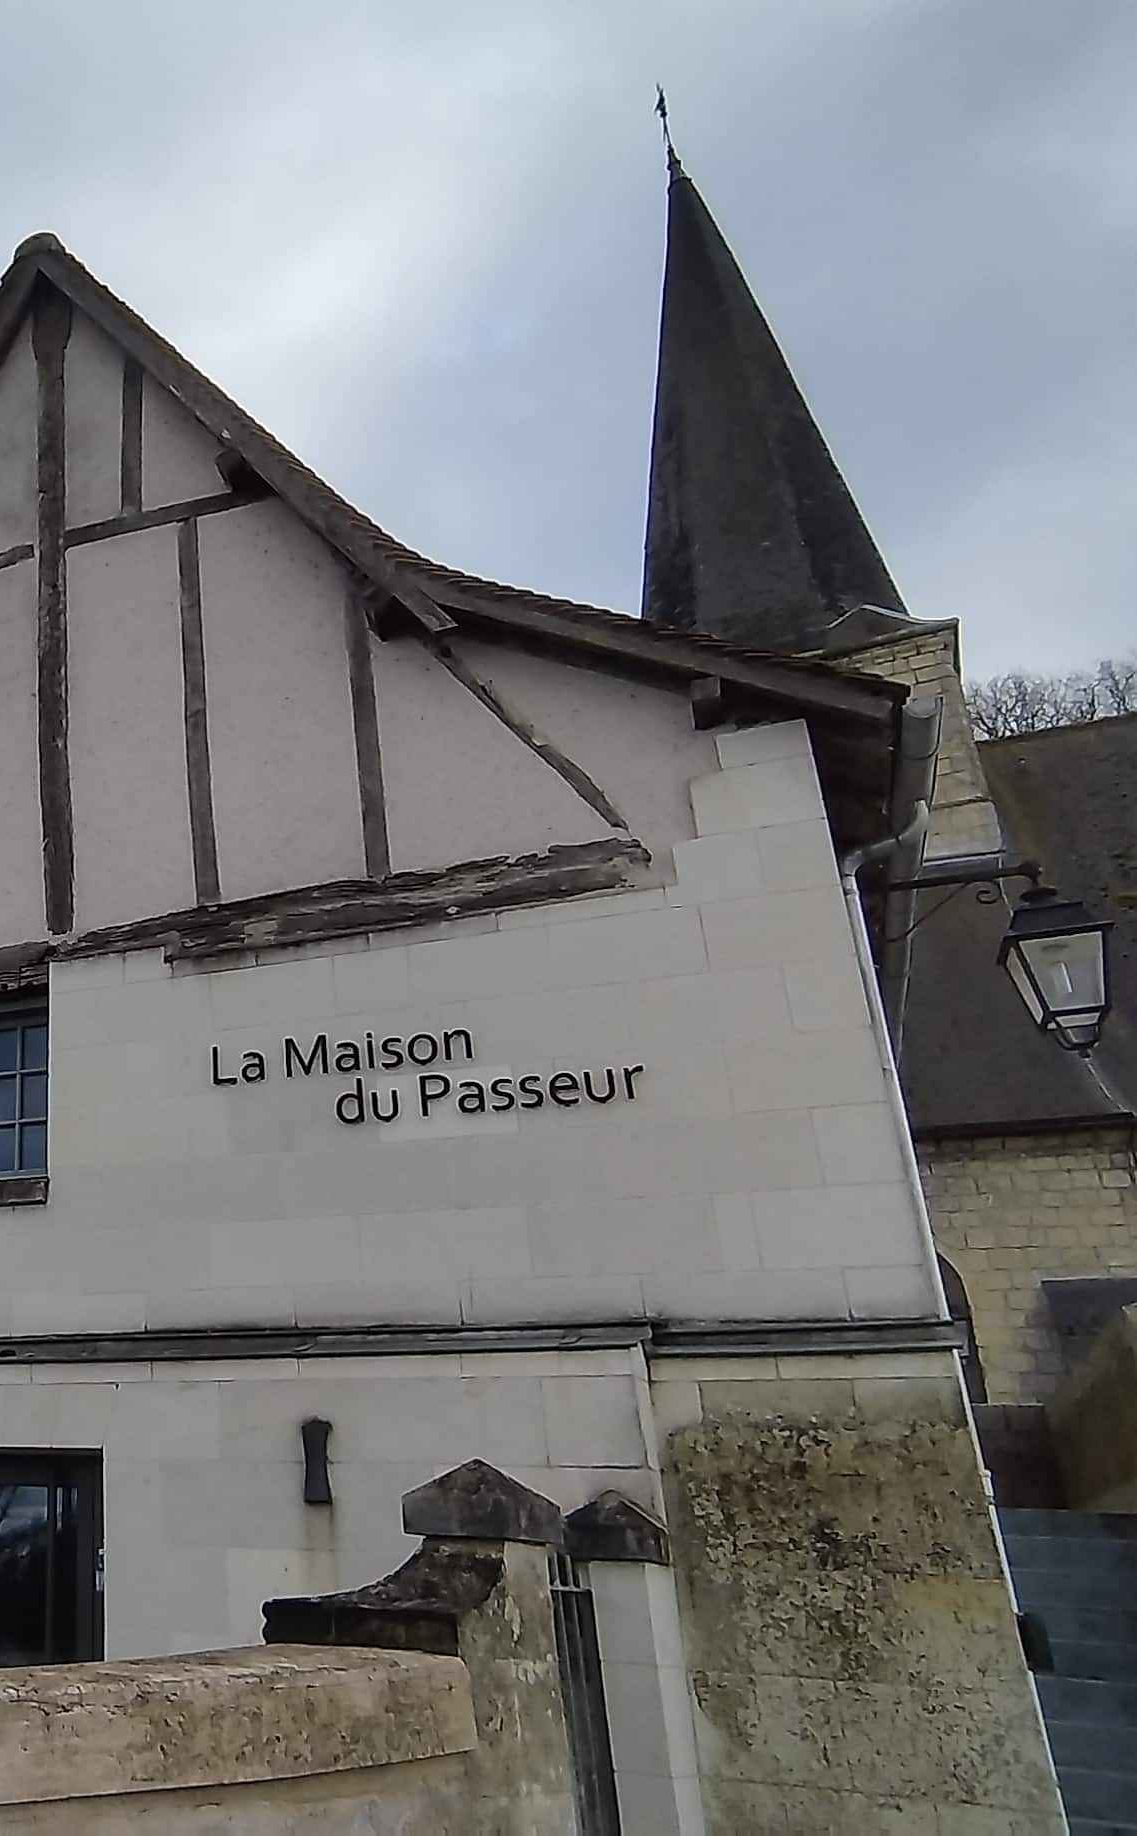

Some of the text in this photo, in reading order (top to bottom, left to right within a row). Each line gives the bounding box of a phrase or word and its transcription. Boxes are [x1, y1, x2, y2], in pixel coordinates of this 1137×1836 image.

[212, 1029, 474, 1087] La Maison
[336, 1064, 645, 1127] du Passeur
